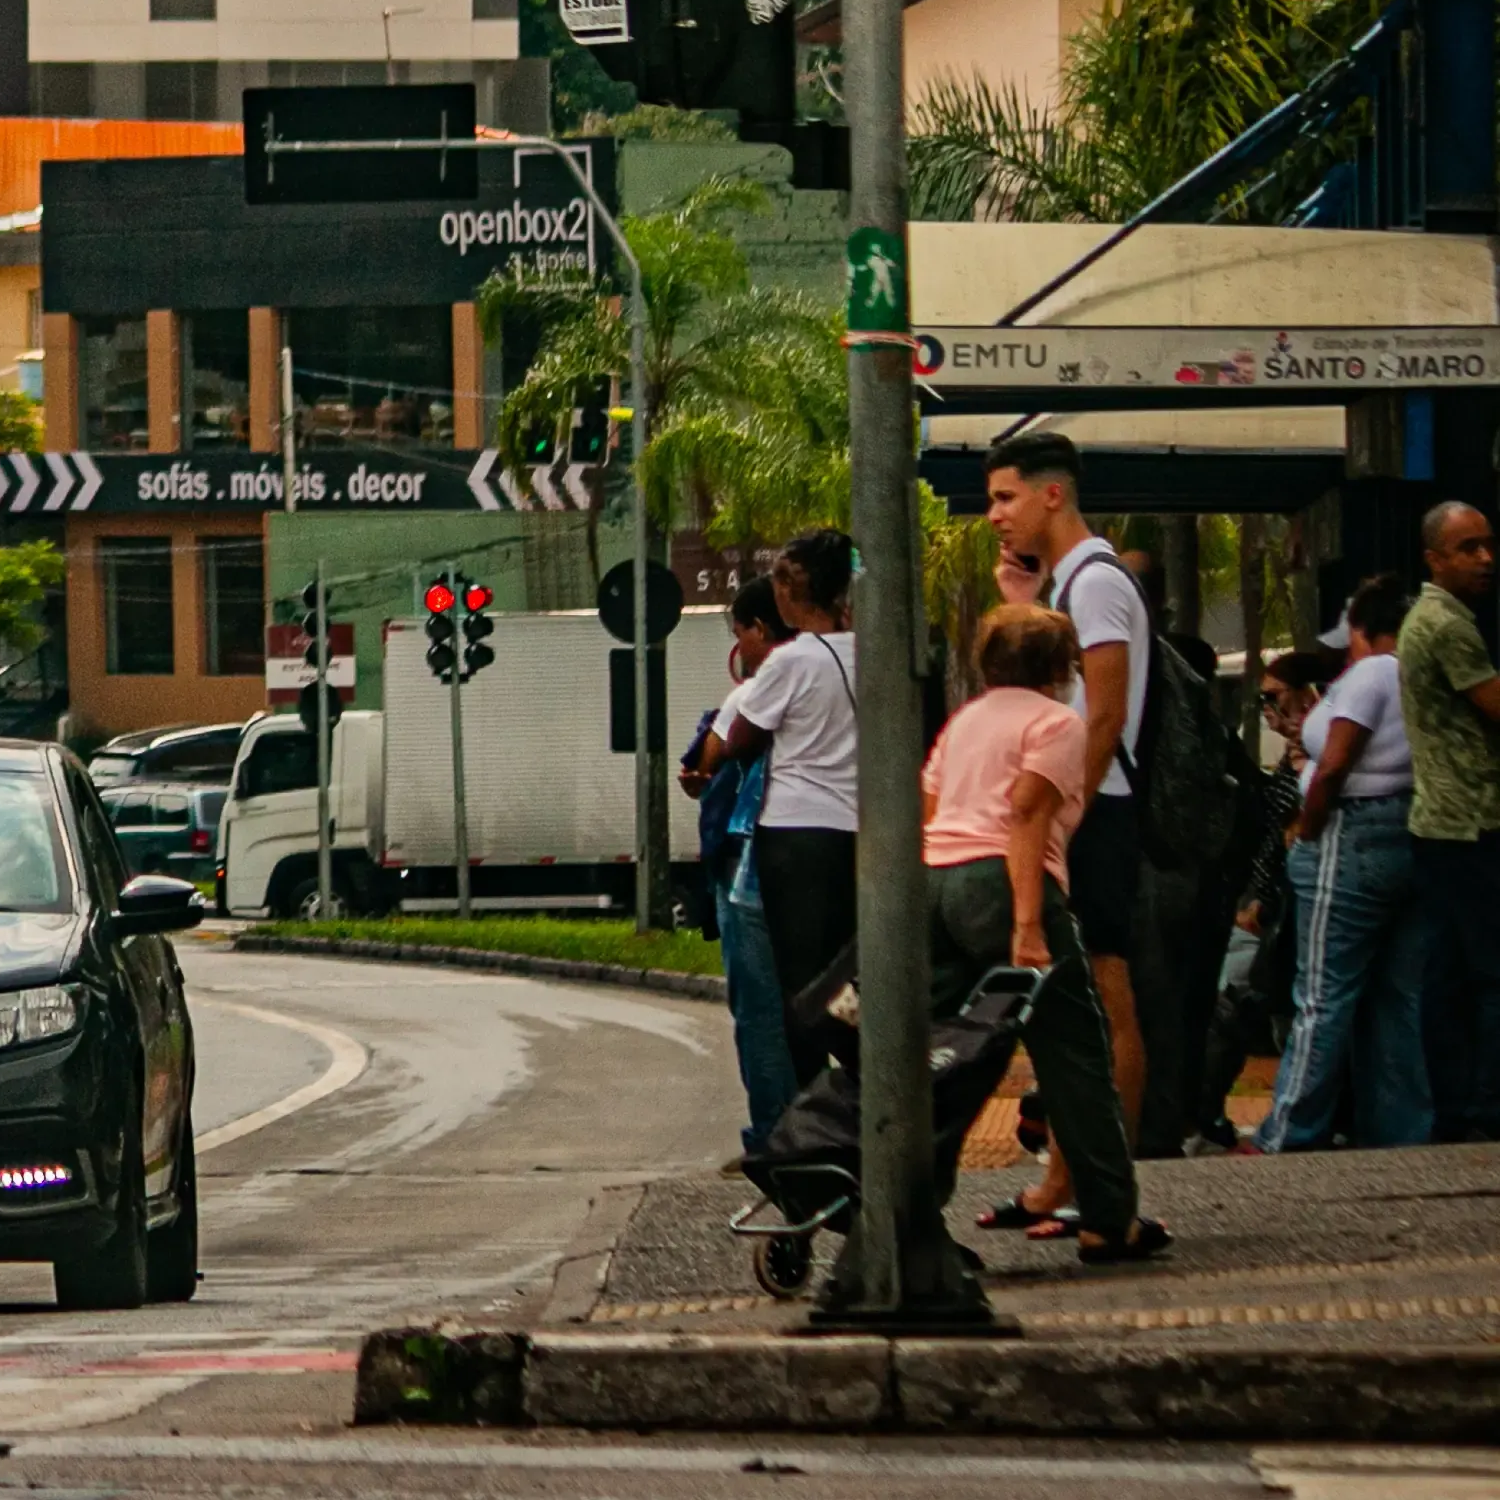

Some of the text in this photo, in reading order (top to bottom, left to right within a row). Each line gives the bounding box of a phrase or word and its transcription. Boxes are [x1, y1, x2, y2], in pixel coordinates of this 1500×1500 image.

[440, 197, 587, 257] openbox2
[952, 343, 1048, 368] EMTU
[1263, 354, 1485, 380] SANTO MARO
[137, 460, 210, 501] sofás
[230, 461, 327, 501] móveis
[347, 463, 427, 501] decor
